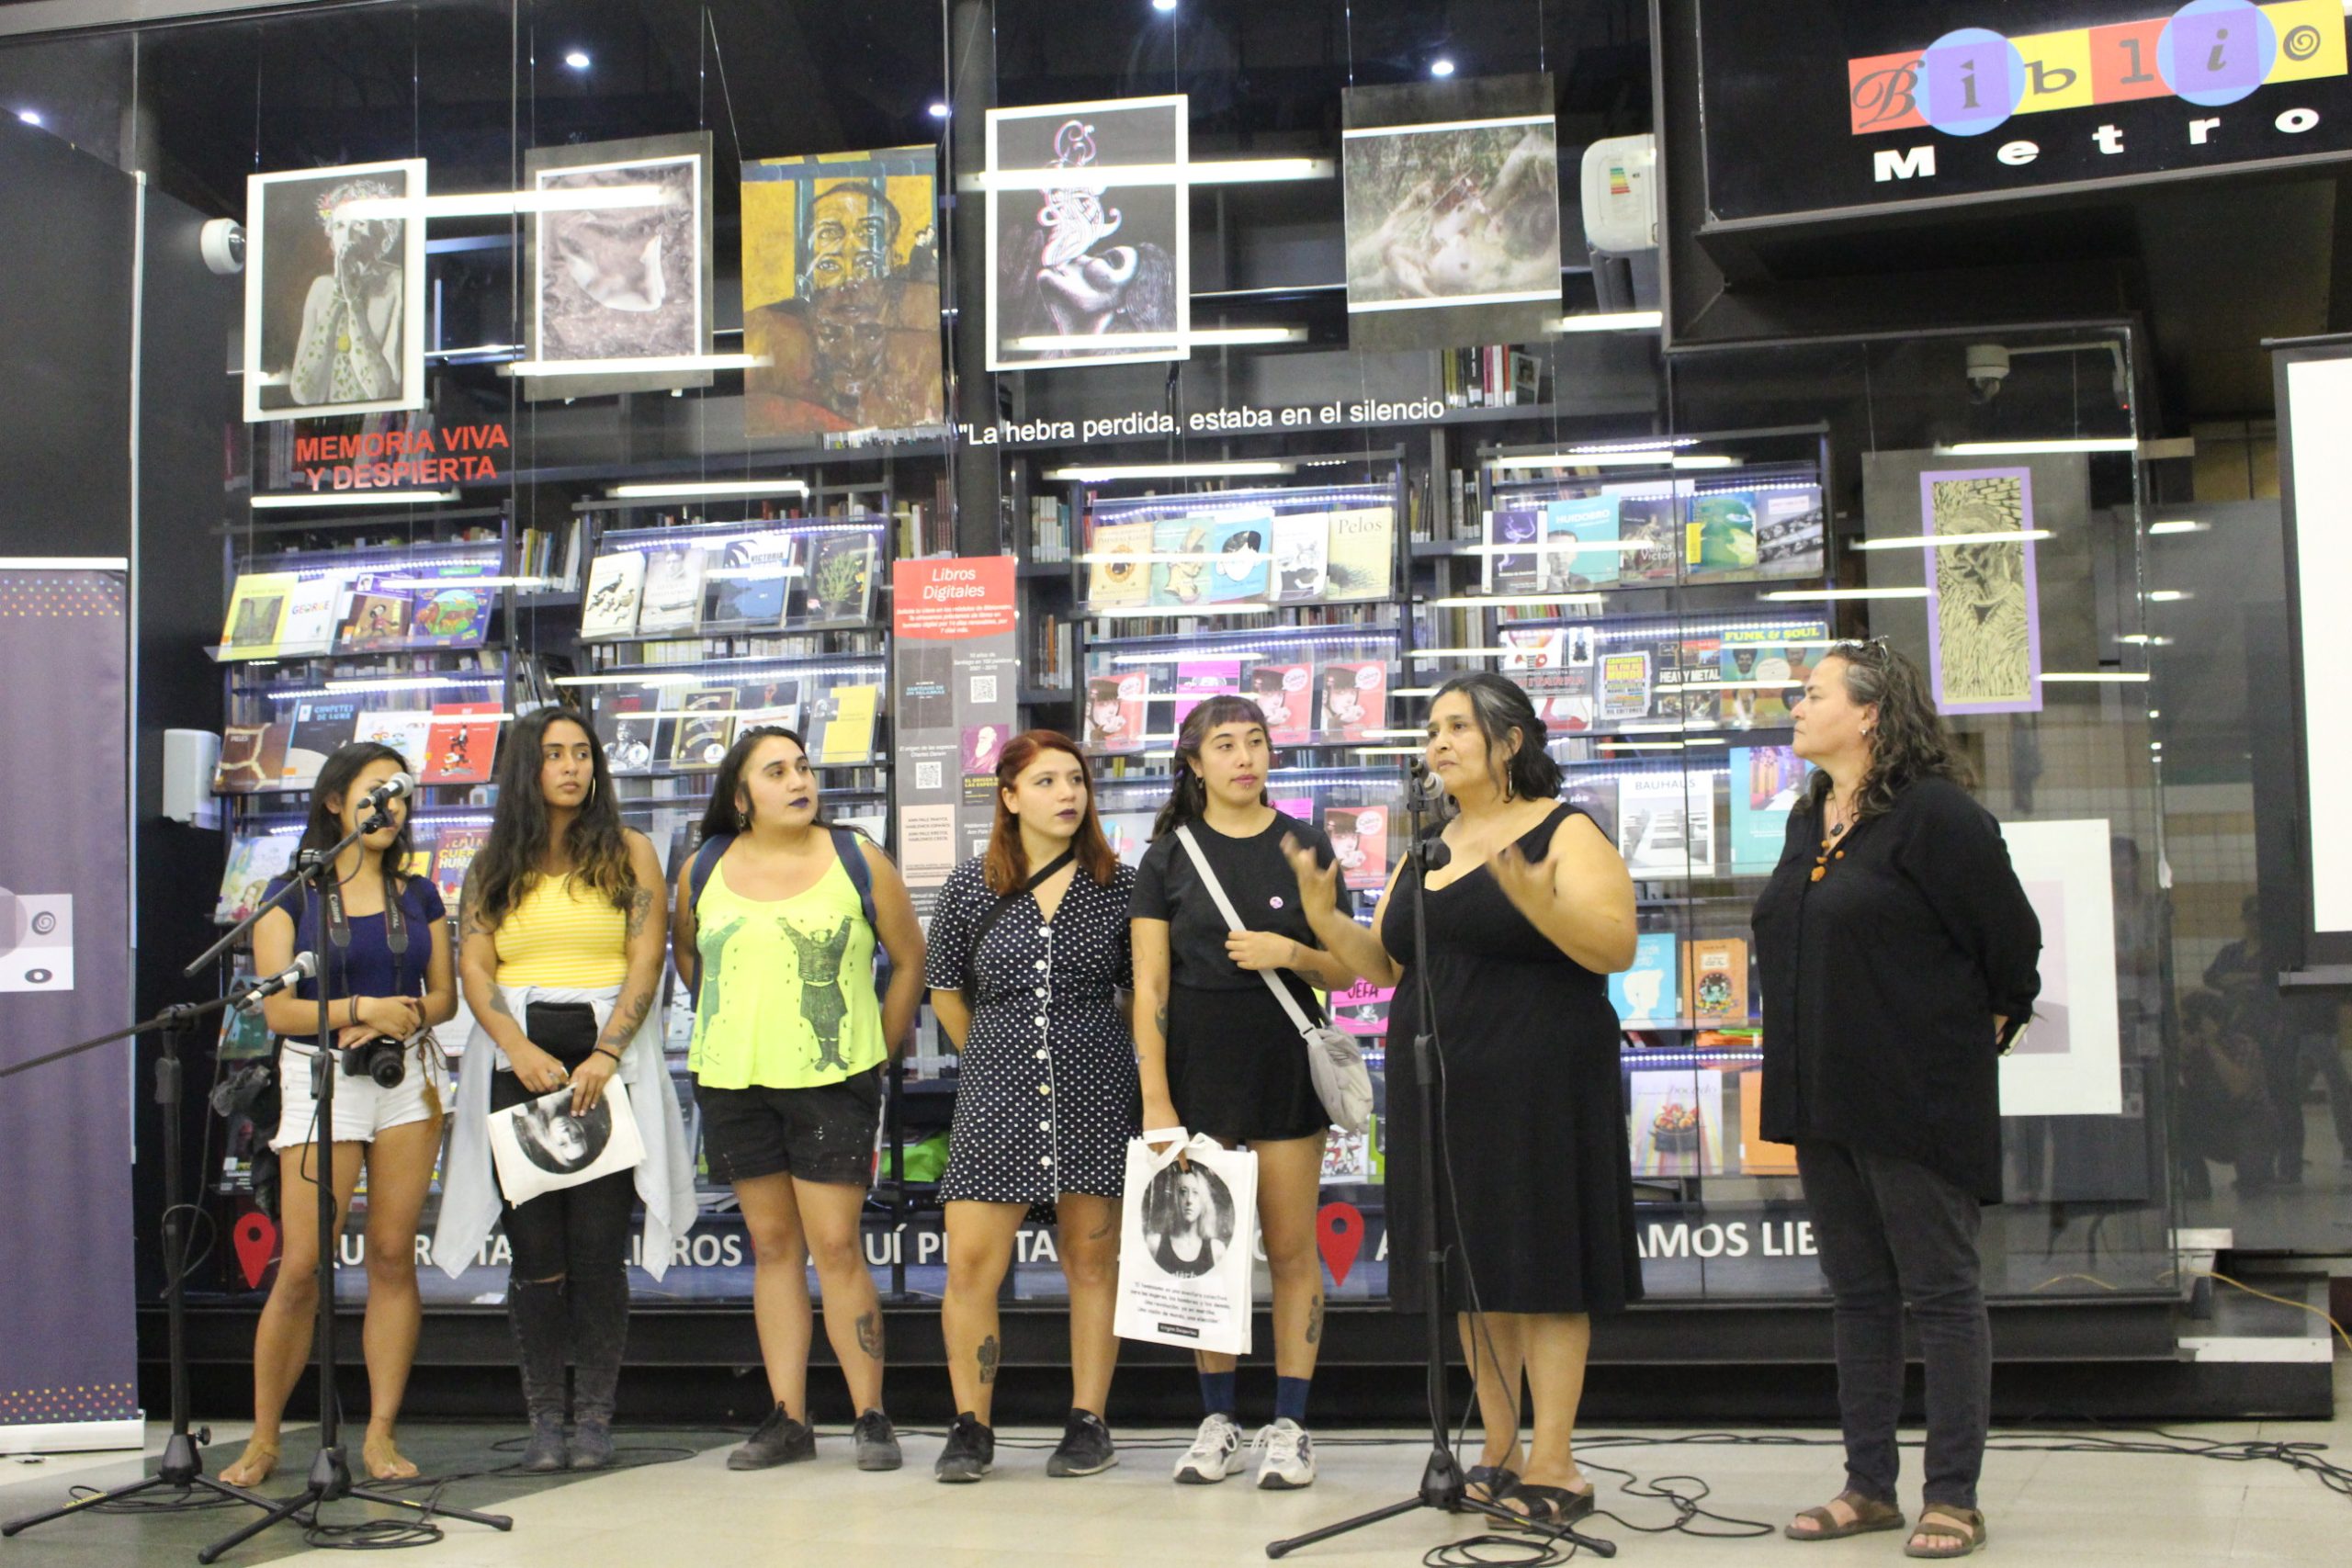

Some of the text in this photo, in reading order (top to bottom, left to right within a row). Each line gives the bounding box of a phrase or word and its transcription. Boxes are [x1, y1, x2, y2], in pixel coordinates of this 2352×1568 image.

[1873, 107, 2320, 183] Metro
[1006, 418, 1074, 442] hebra
[1082, 411, 1181, 443] perdida,
[1189, 405, 1272, 431] estaba
[1281, 407, 1311, 426] en
[1319, 400, 1341, 423] el
[1350, 397, 1445, 423] silencio
[296, 424, 509, 463] MEMORIA VIVA
[306, 456, 497, 491] Y DESPIERTA
[1339, 516, 1382, 535] Pelos
[932, 568, 977, 582] Libros
[922, 584, 986, 602] Digitales
[1724, 627, 1820, 641] FUNK & SOUL
[1517, 675, 1586, 687] UITARRA
[1690, 669, 1720, 682] METAL
[1635, 780, 1696, 791] BAUHAUS
[439, 849, 476, 859] CUER
[1347, 982, 1379, 999] JEFA
